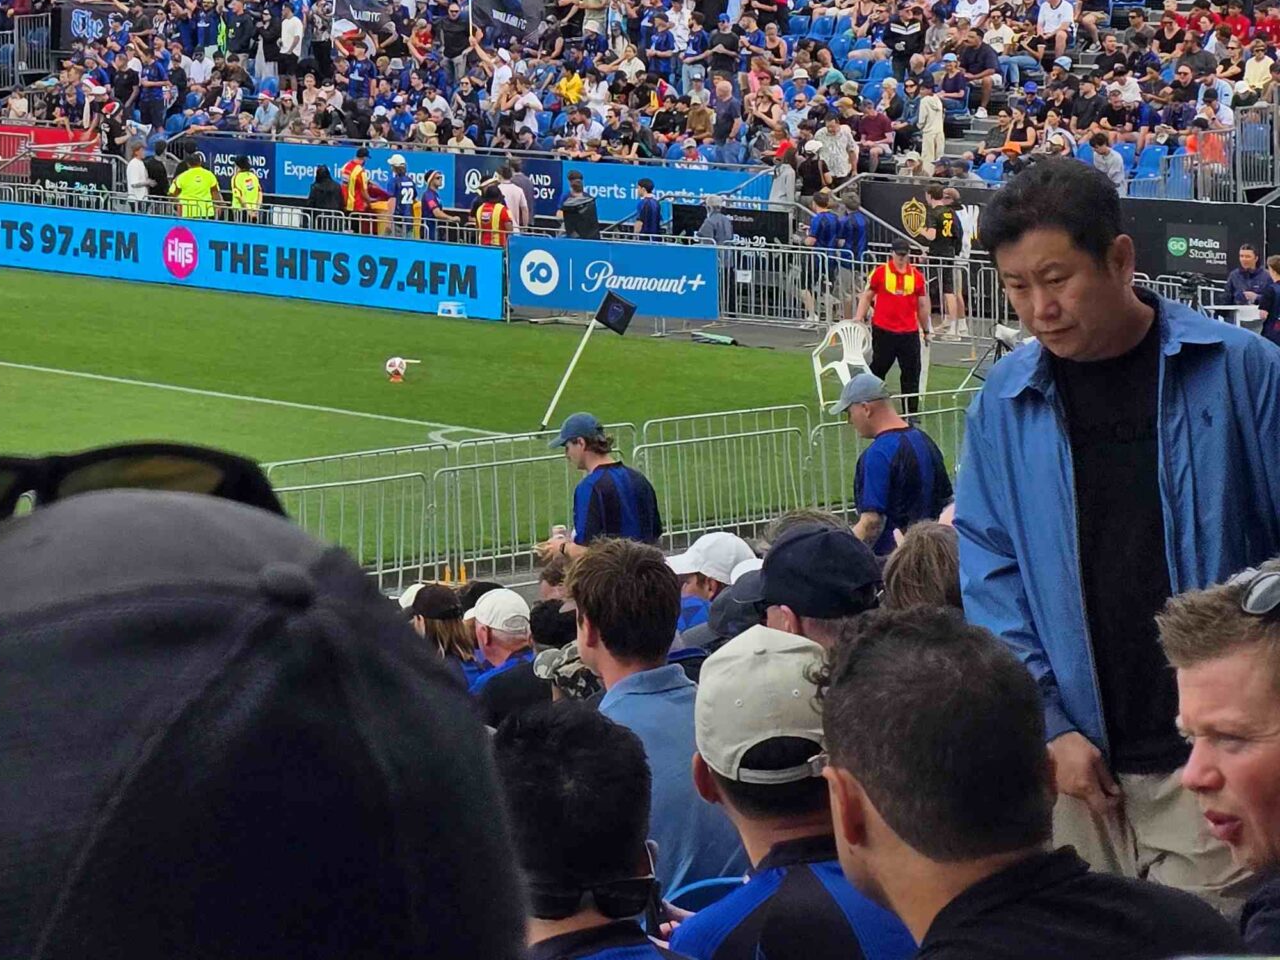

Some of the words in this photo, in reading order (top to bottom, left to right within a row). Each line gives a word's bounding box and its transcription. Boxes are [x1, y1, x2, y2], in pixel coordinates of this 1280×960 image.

[401, 187, 414, 204] 22
[40, 224, 140, 263] 97.4FM
[1170, 241, 1186, 250] GO
[1189, 238, 1220, 249] Media
[1189, 249, 1227, 260] Stadium
[209, 240, 268, 276] THE
[276, 246, 350, 285] HITS
[358, 254, 478, 299] 97.4FM
[526, 261, 553, 283] 10
[581, 260, 706, 295] Paramount+
